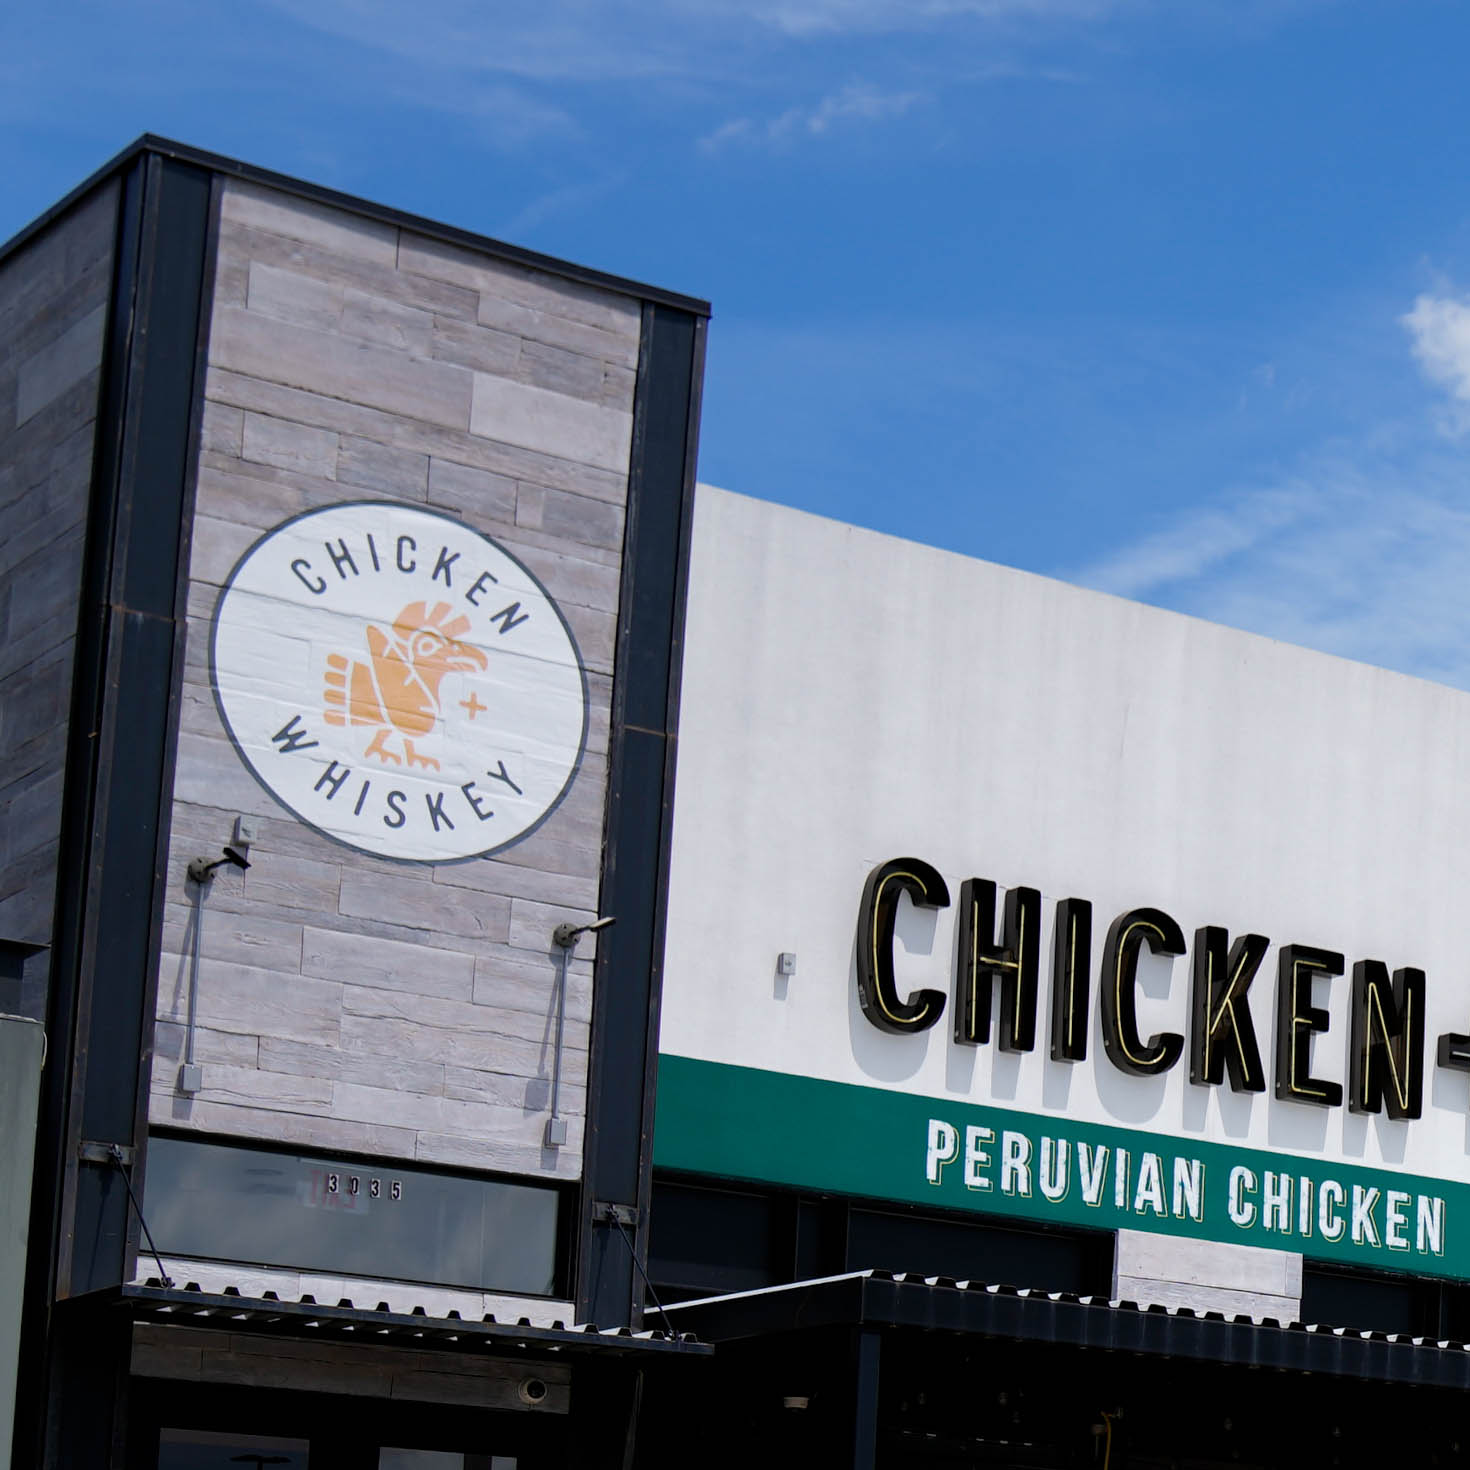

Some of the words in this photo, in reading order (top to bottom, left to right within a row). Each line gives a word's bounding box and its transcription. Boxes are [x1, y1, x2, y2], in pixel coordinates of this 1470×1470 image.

[290, 533, 530, 634] CHICKEN
[271, 715, 524, 832] WHISKEY
[328, 1173, 402, 1201] 3035
[926, 1118, 1206, 1223] PERUVIAN
[1228, 1166, 1445, 1257] CHICKEN
